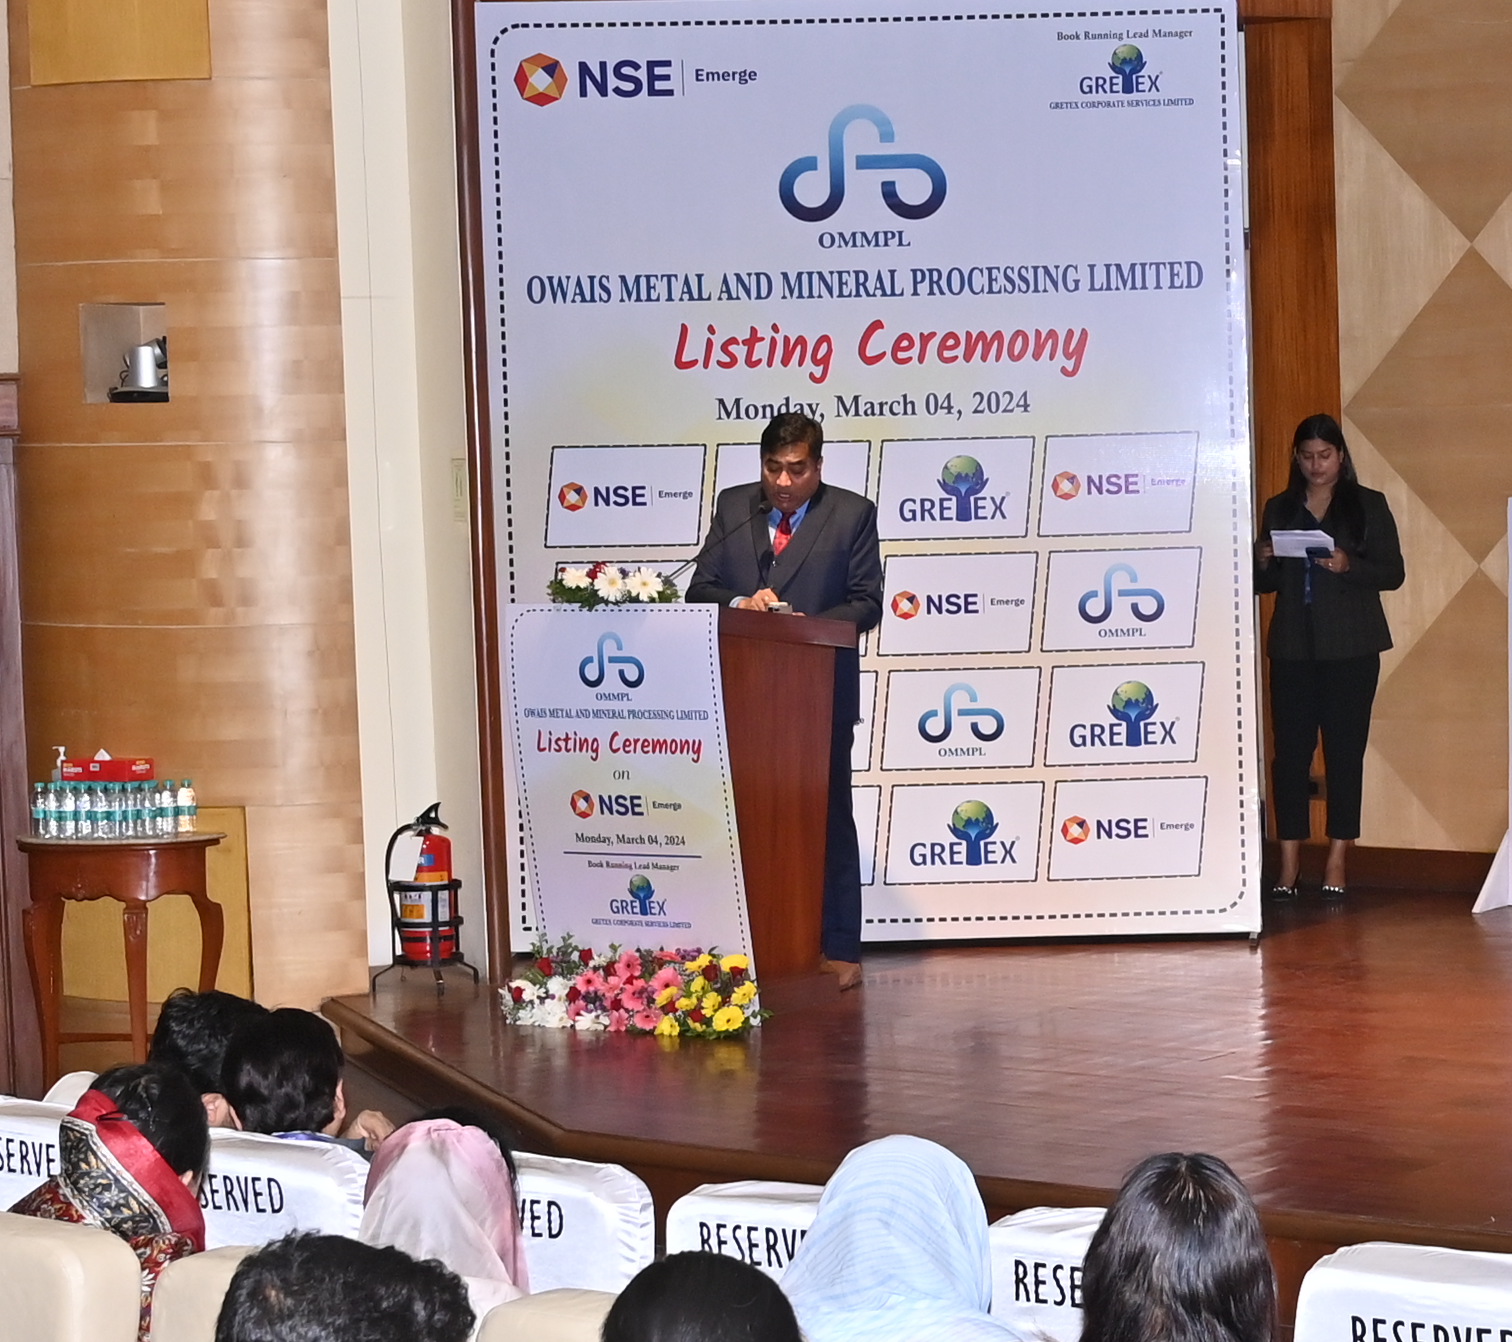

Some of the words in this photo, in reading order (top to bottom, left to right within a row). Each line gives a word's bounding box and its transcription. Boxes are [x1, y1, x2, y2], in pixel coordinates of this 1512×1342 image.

[1057, 31, 1081, 41] Book
[1084, 30, 1123, 41] Running
[1126, 29, 1149, 39] Lead
[1152, 29, 1193, 40] Manager
[578, 59, 674, 98] NSE
[694, 66, 758, 87] Emerge
[1079, 74, 1161, 94] GRETEX
[1049, 101, 1079, 110] GRETEX
[1081, 100, 1125, 109] CORPORATE
[1127, 99, 1161, 108] SERVICES
[1163, 98, 1194, 107] LIMITED
[817, 229, 911, 249] OMMPL
[526, 274, 612, 304] OWAIS
[618, 272, 711, 302] METAL
[717, 271, 773, 301] AND
[781, 268, 904, 299] MINERAL
[910, 263, 1081, 296] PROCESSING
[1087, 260, 1204, 292] LIMITED
[673, 322, 834, 384] Listing
[857, 319, 1089, 378] Ceremony
[834, 394, 918, 417] March
[924, 392, 963, 420] 04,
[972, 390, 1031, 414] 2024
[1087, 472, 1140, 495] NSE
[593, 485, 648, 507] NSE
[657, 490, 693, 501] Emerge
[926, 593, 980, 615] NSE
[990, 597, 1026, 608] Emerge
[1097, 627, 1147, 638] OMMPL
[595, 692, 632, 702] OMMPL
[1069, 718, 1177, 749] GRETEX
[537, 729, 600, 762] Listing
[609, 731, 703, 763] Ceremony
[613, 770, 631, 780] on
[598, 794, 645, 816] NSE
[1096, 817, 1150, 840] NSE
[1159, 820, 1195, 832] Emerge
[575, 832, 614, 847] Monday,
[616, 834, 646, 846] March
[647, 835, 662, 848] 04,
[664, 835, 686, 846] 2024
[199, 1173, 284, 1215] SERVED
[699, 1222, 808, 1271] RESERV
[1014, 1259, 1084, 1308] RESE
